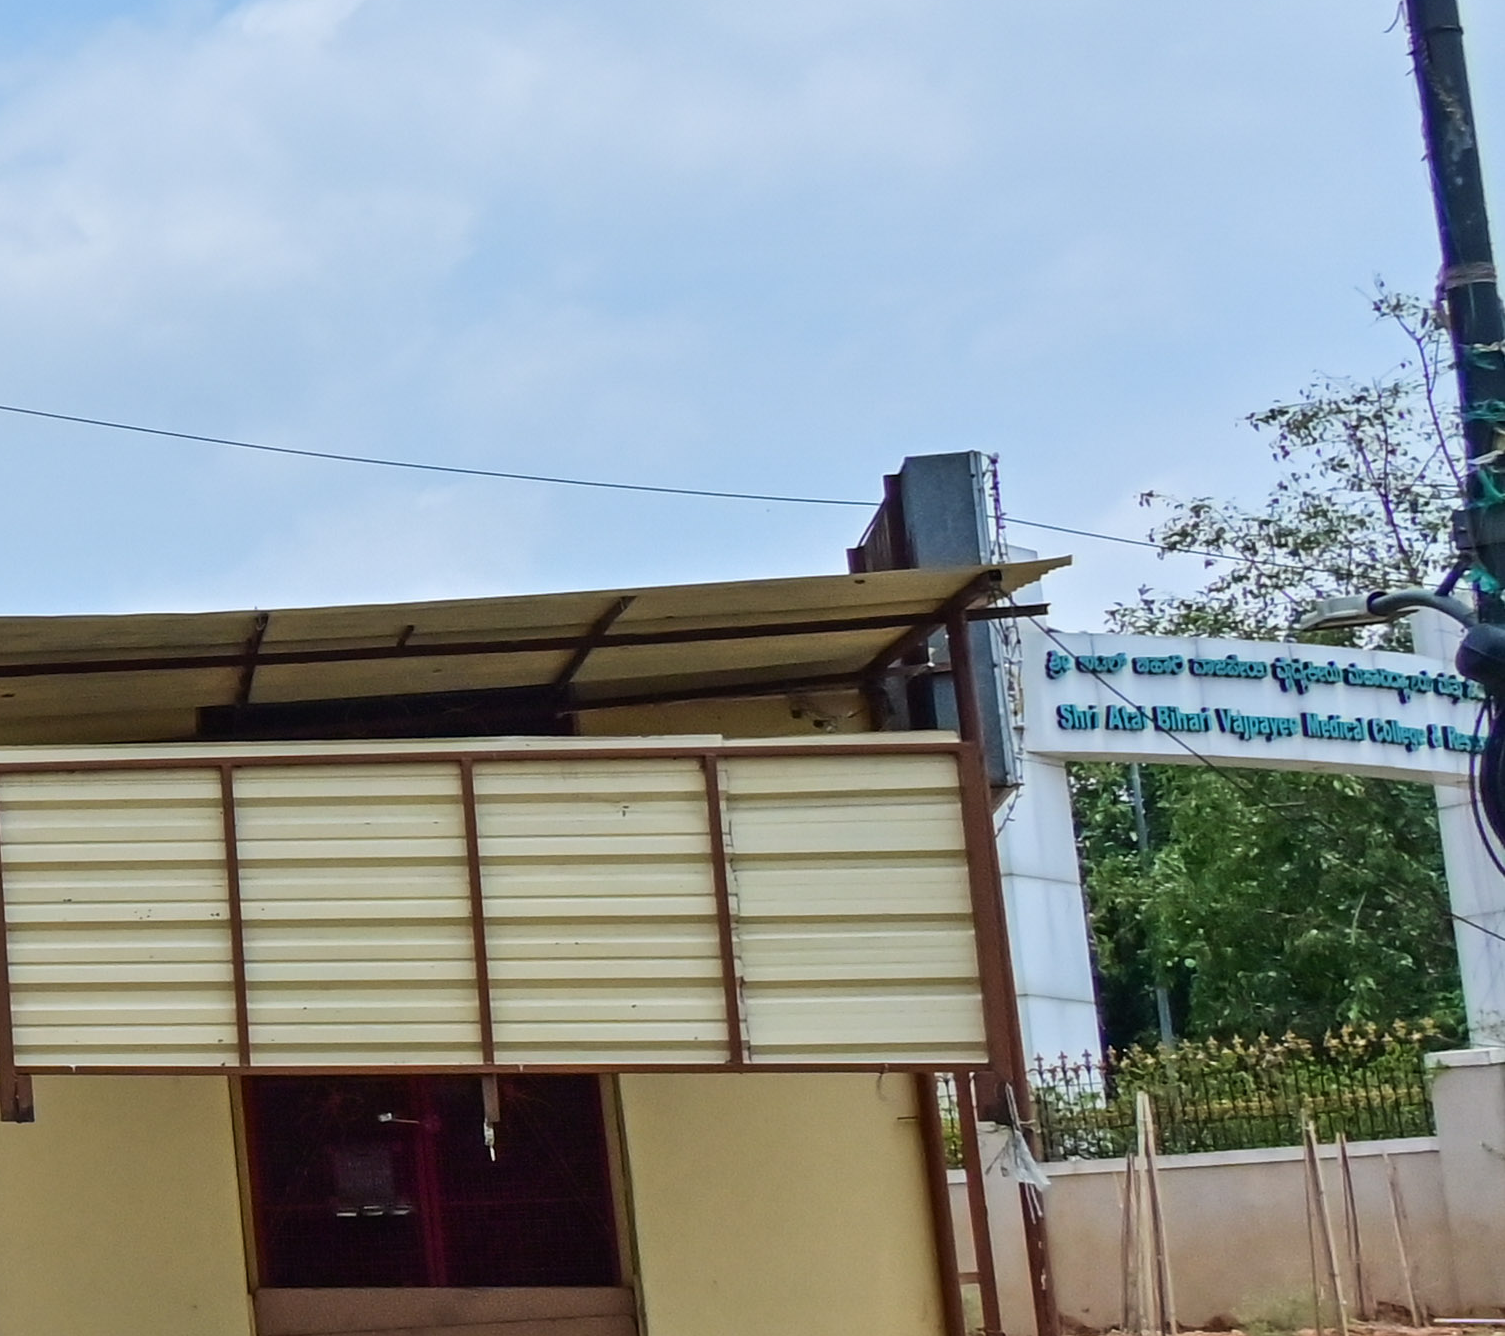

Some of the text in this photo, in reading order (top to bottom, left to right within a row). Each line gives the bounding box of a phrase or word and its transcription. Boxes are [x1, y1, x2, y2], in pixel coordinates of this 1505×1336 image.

[1057, 704, 1099, 730] Shri
[1106, 704, 1148, 731] Atal
[1152, 705, 1211, 732] Bihari
[1214, 708, 1299, 742] Vajpayee
[1300, 712, 1366, 742] Medical
[1367, 717, 1427, 753] College
[1427, 723, 1441, 748] &
